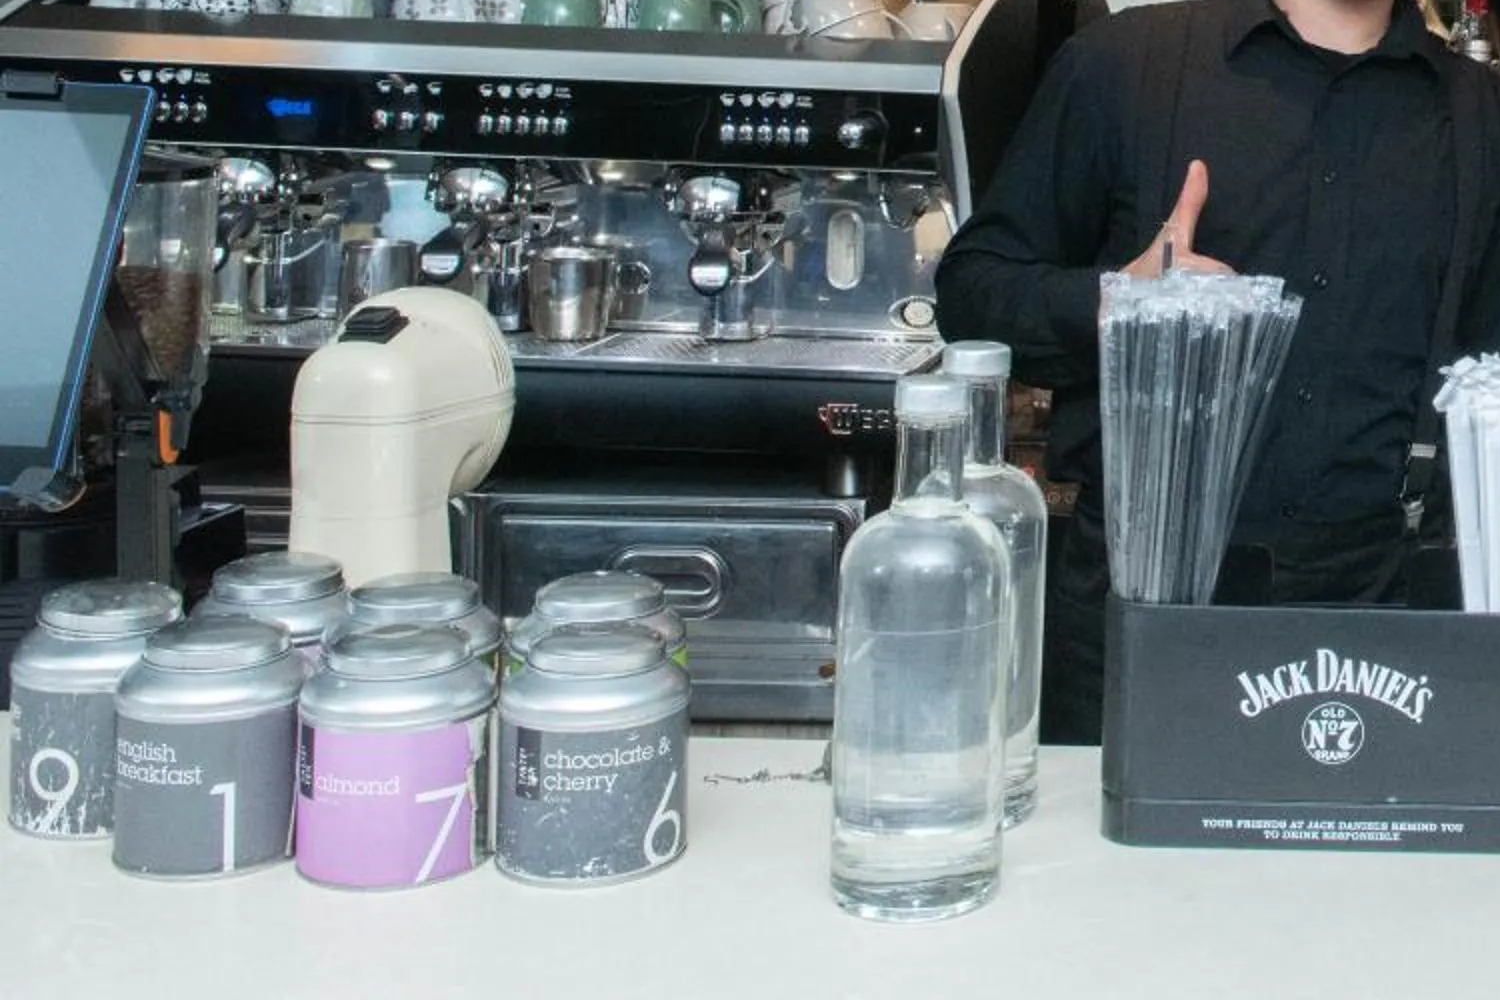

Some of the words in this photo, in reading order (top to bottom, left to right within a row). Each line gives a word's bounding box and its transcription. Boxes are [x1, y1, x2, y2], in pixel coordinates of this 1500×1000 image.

[1236, 660, 1315, 718] JACK
[1315, 647, 1434, 725] DANIEL'S
[1320, 708, 1347, 719] OLD
[543, 743, 656, 770] chocolate
[658, 735, 673, 756] &
[117, 759, 204, 786] breakfast
[314, 773, 401, 797] almond
[543, 771, 619, 794] cherry
[29, 747, 80, 834] 9
[208, 781, 237, 873] 1
[415, 781, 469, 884] 7
[643, 769, 681, 866] 6
[1202, 818, 1234, 830] YOUR
[1236, 818, 1288, 830] FRIENDS
[1289, 820, 1305, 830] AT
[1307, 820, 1335, 831] JACK
[1440, 823, 1465, 833] YOU
[1263, 829, 1282, 840] TO
[1283, 829, 1320, 841] DRINK
